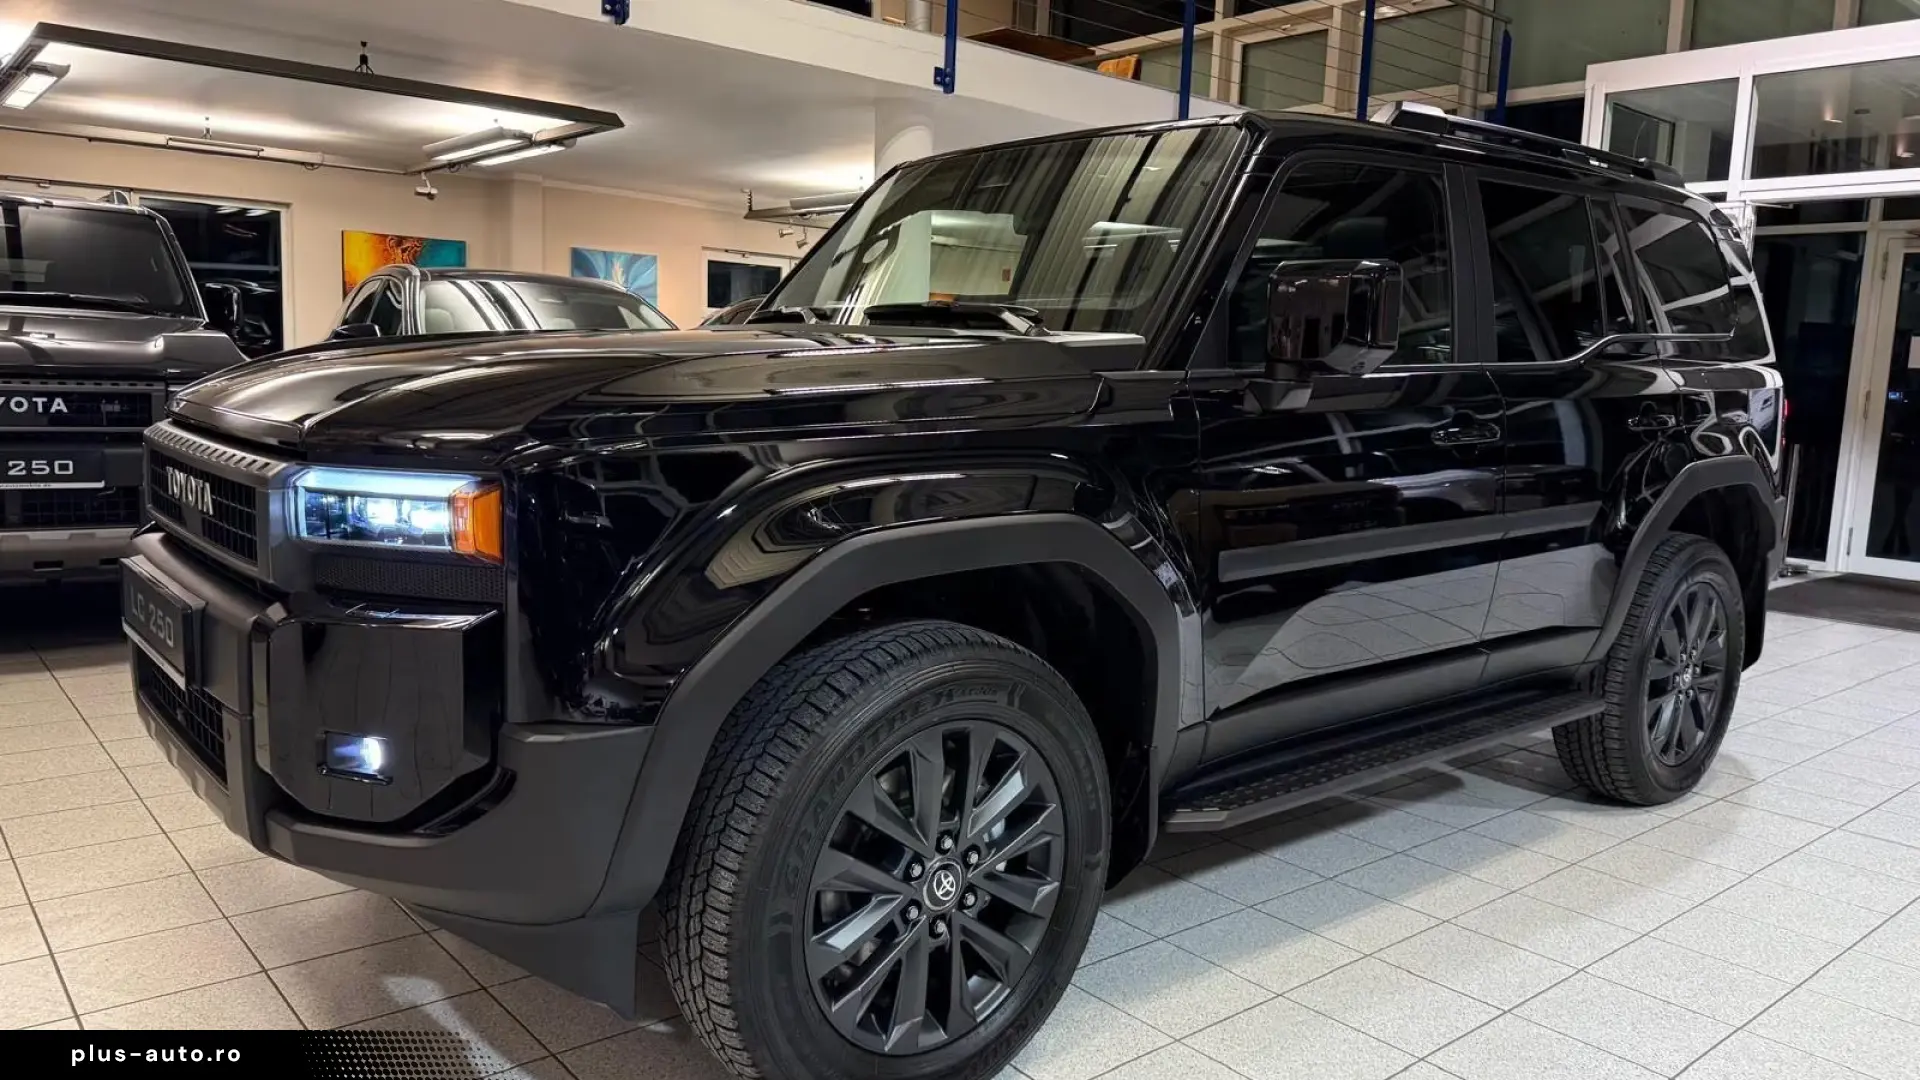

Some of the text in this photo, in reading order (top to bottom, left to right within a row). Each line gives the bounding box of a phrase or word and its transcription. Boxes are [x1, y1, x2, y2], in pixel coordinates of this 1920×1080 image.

[7, 459, 74, 476] 250
[166, 466, 215, 516] TOYOTA
[129, 583, 174, 649] LC 250
